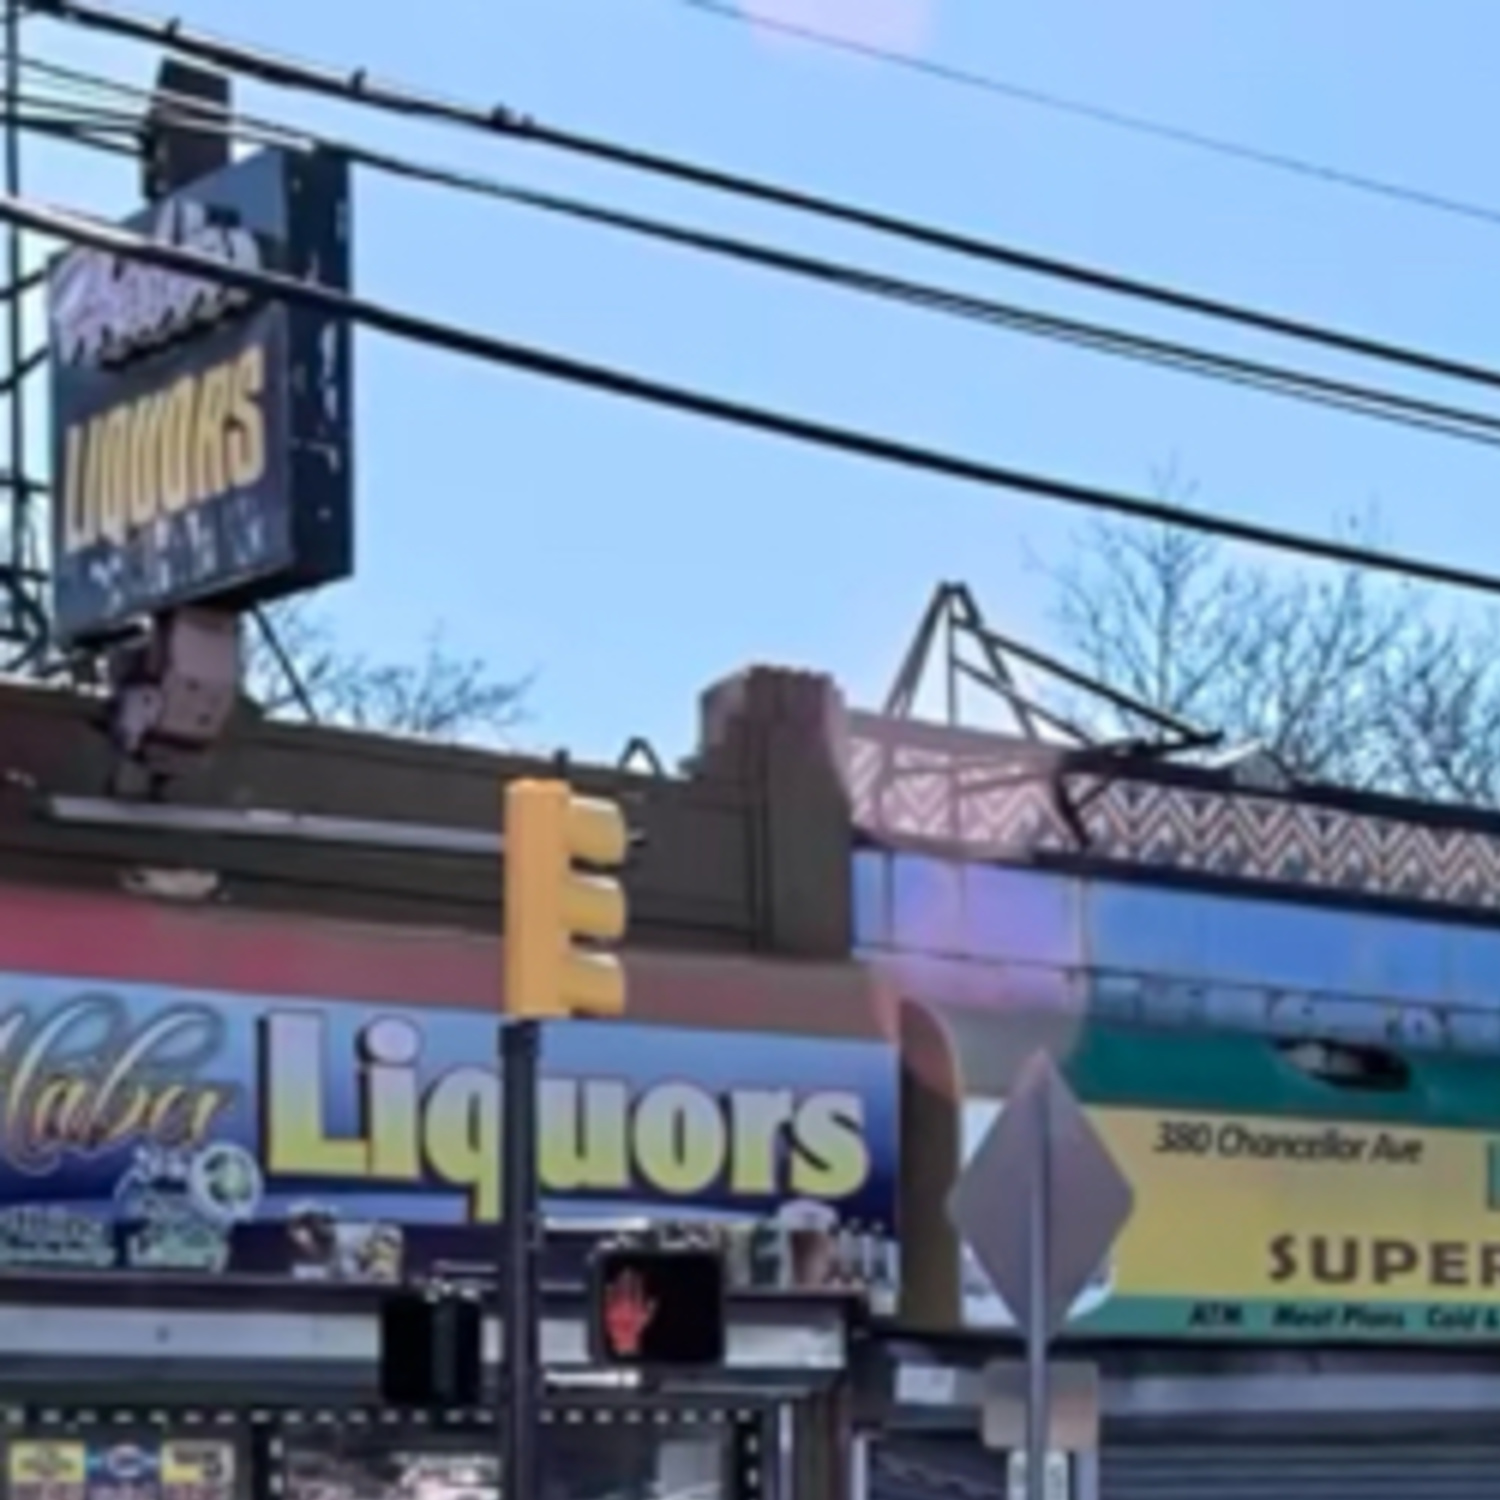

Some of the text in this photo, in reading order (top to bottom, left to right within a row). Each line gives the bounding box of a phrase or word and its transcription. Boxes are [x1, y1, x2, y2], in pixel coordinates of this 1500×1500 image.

[65, 343, 267, 553] LIQUORS
[262, 1008, 870, 1223] Liquors
[1368, 1131, 1424, 1164] Ave
